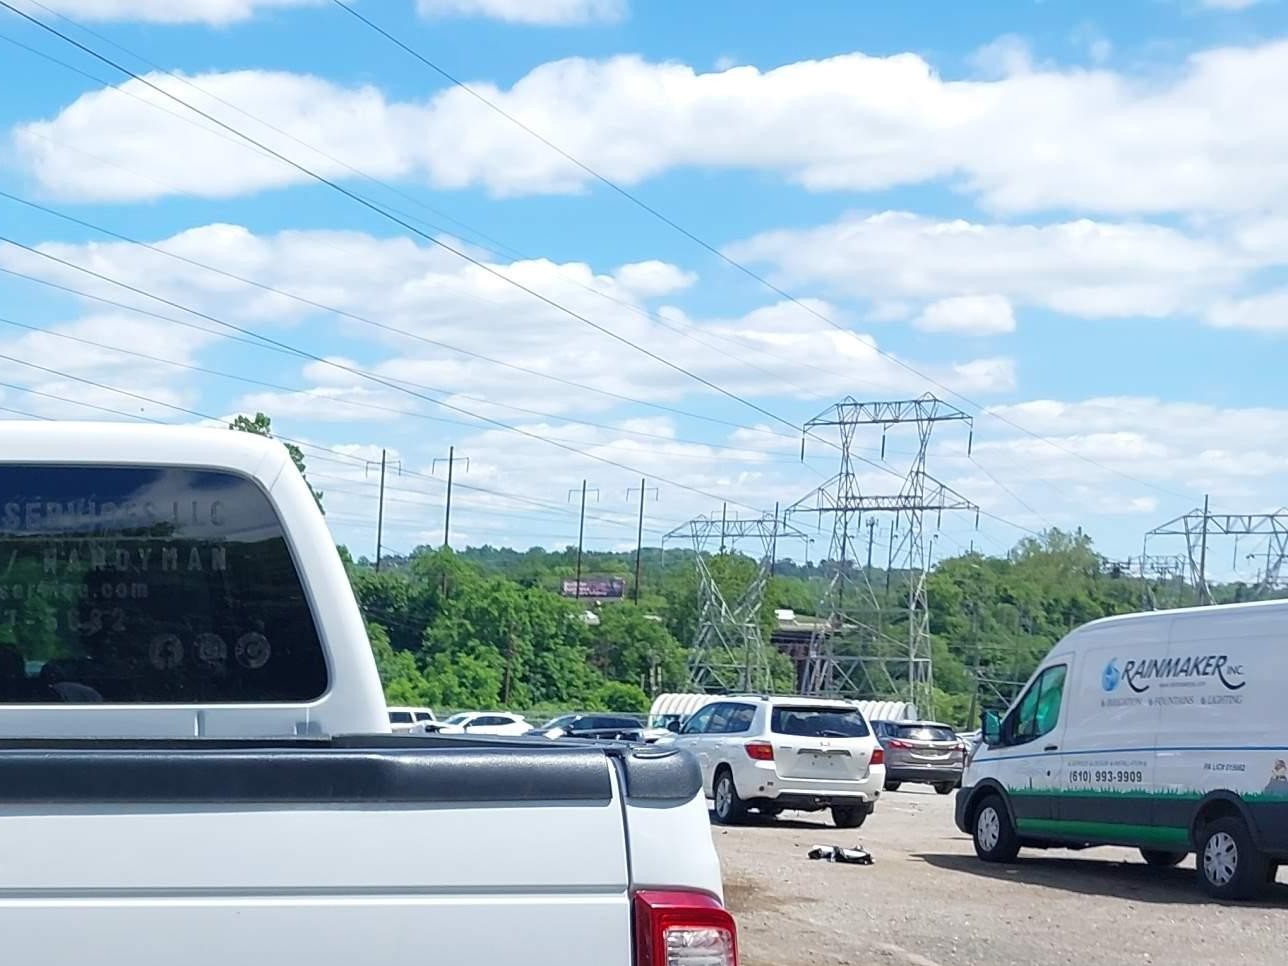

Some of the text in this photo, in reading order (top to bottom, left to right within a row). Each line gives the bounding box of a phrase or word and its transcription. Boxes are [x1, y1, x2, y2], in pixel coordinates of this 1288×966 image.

[43, 547, 227, 573] HANDYMAN
[1121, 655, 1246, 693] RAINMAKER
[1069, 770, 1142, 784] (610) 993-9909
